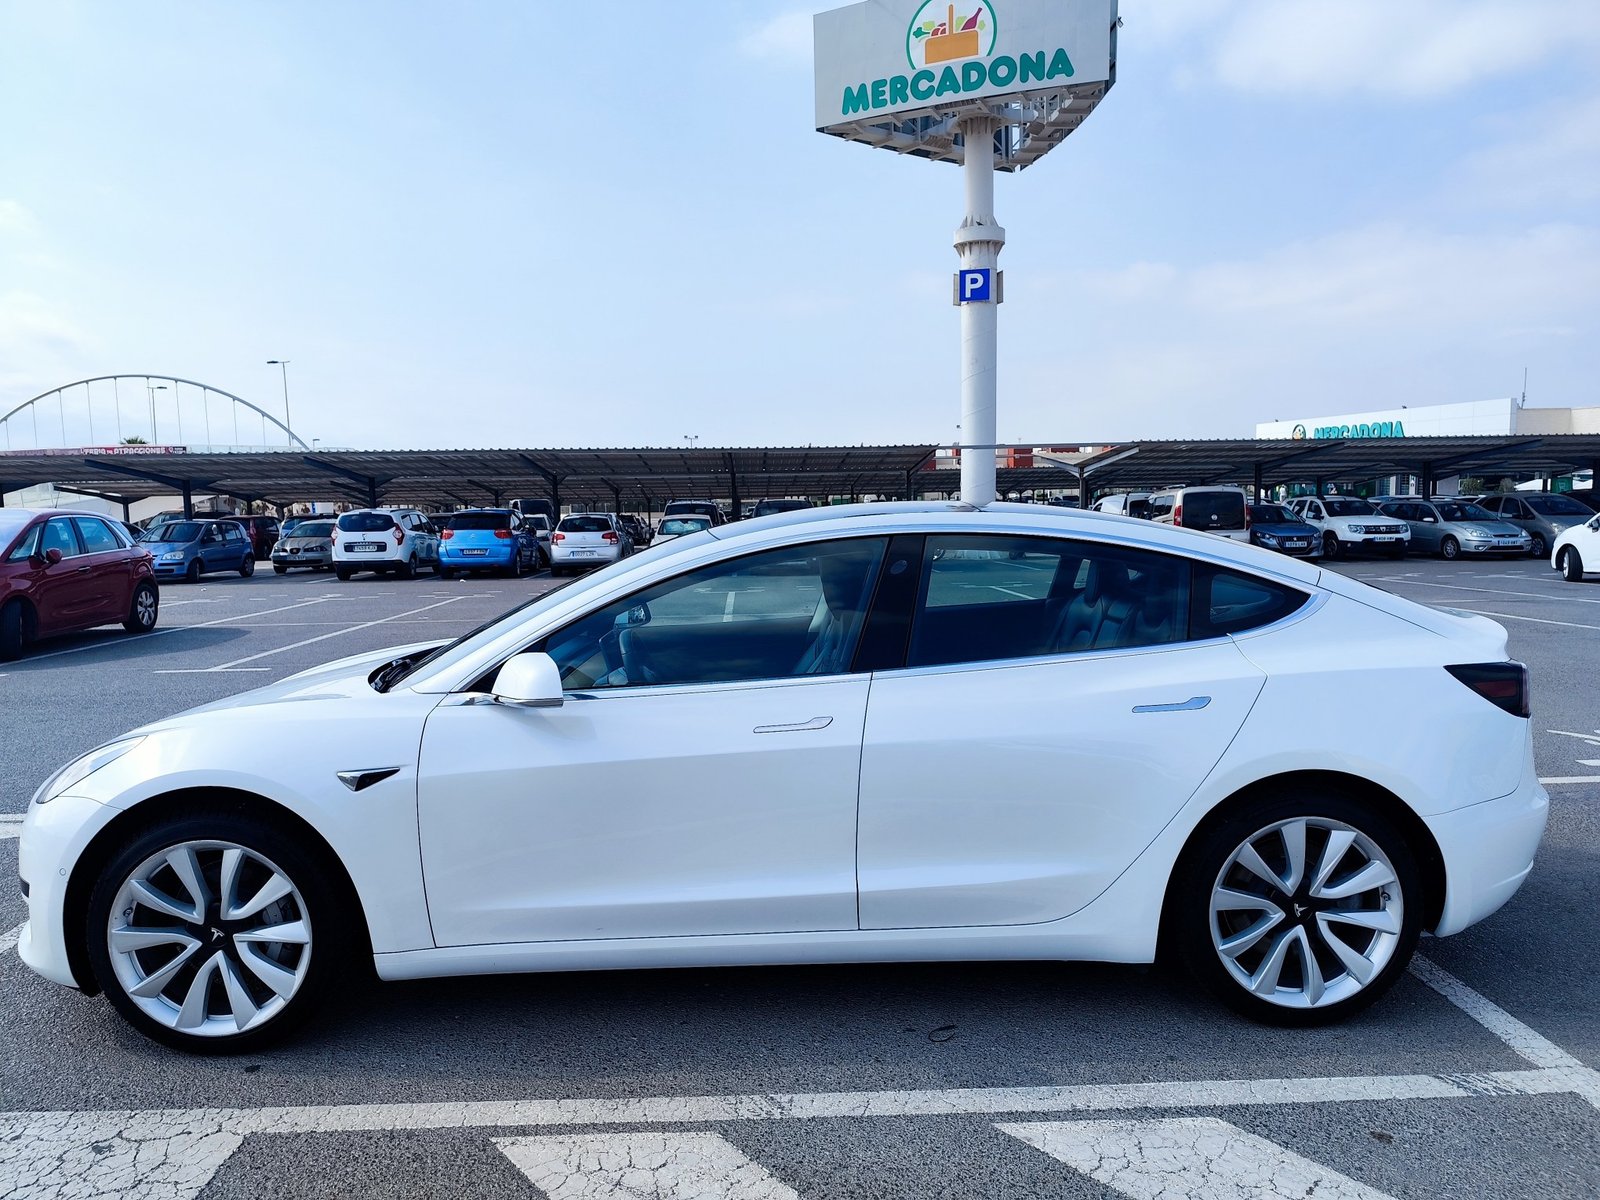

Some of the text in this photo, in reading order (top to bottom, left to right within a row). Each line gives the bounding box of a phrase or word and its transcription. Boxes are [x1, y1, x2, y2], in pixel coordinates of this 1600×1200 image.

[841, 47, 1075, 116] MERCADONA
[965, 273, 984, 298] P
[1314, 421, 1405, 439] MERCADONA
